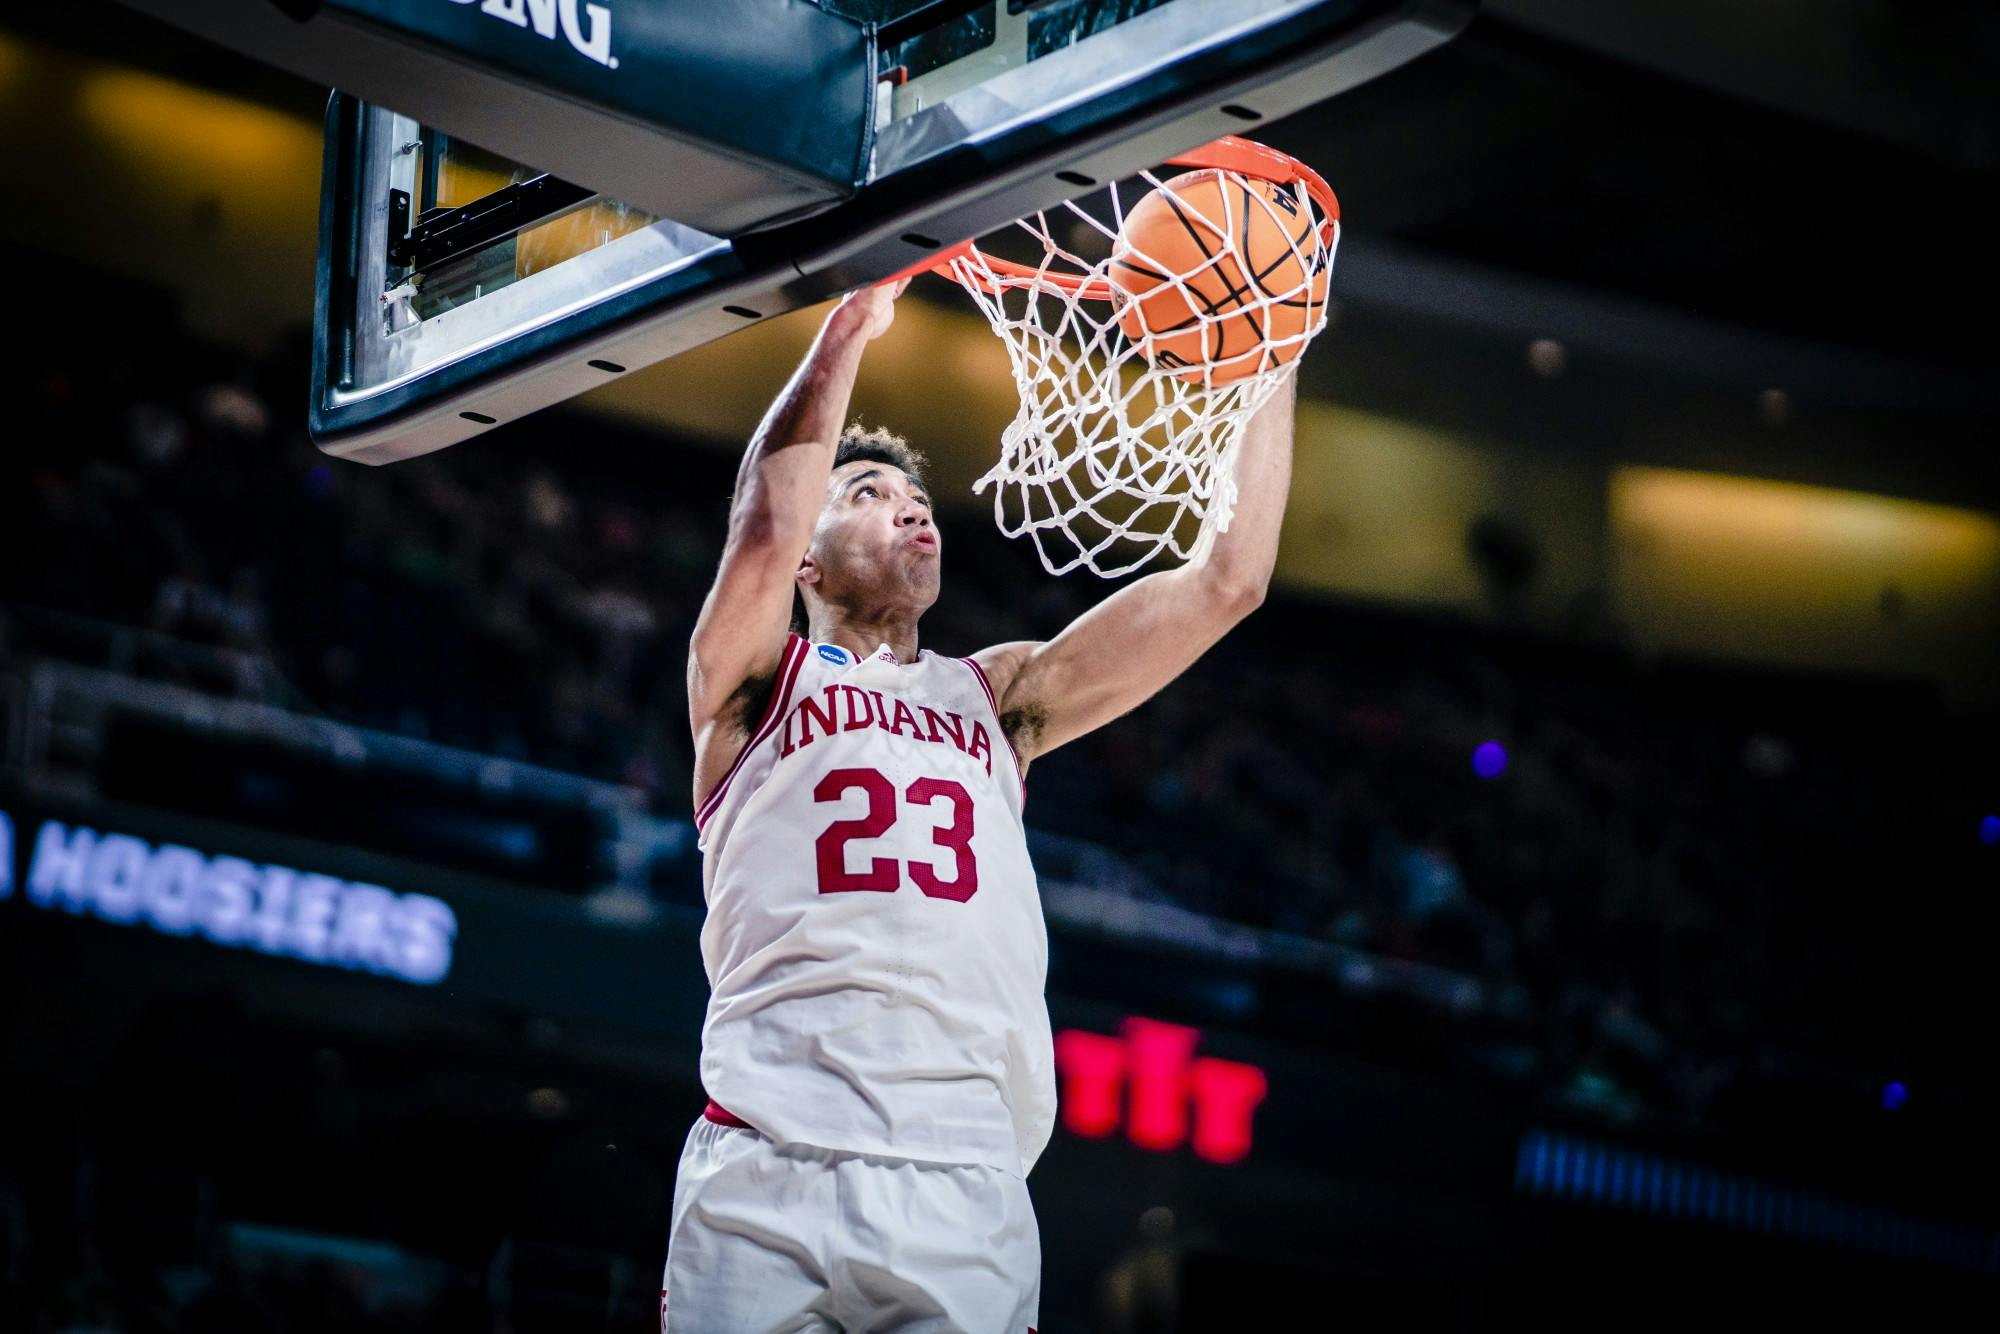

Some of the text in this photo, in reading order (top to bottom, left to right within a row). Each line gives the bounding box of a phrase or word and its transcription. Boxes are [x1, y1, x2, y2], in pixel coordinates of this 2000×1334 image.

[780, 684, 992, 778] INDIANA
[27, 820, 457, 986] HOOSIERS
[814, 768, 978, 904] 23
